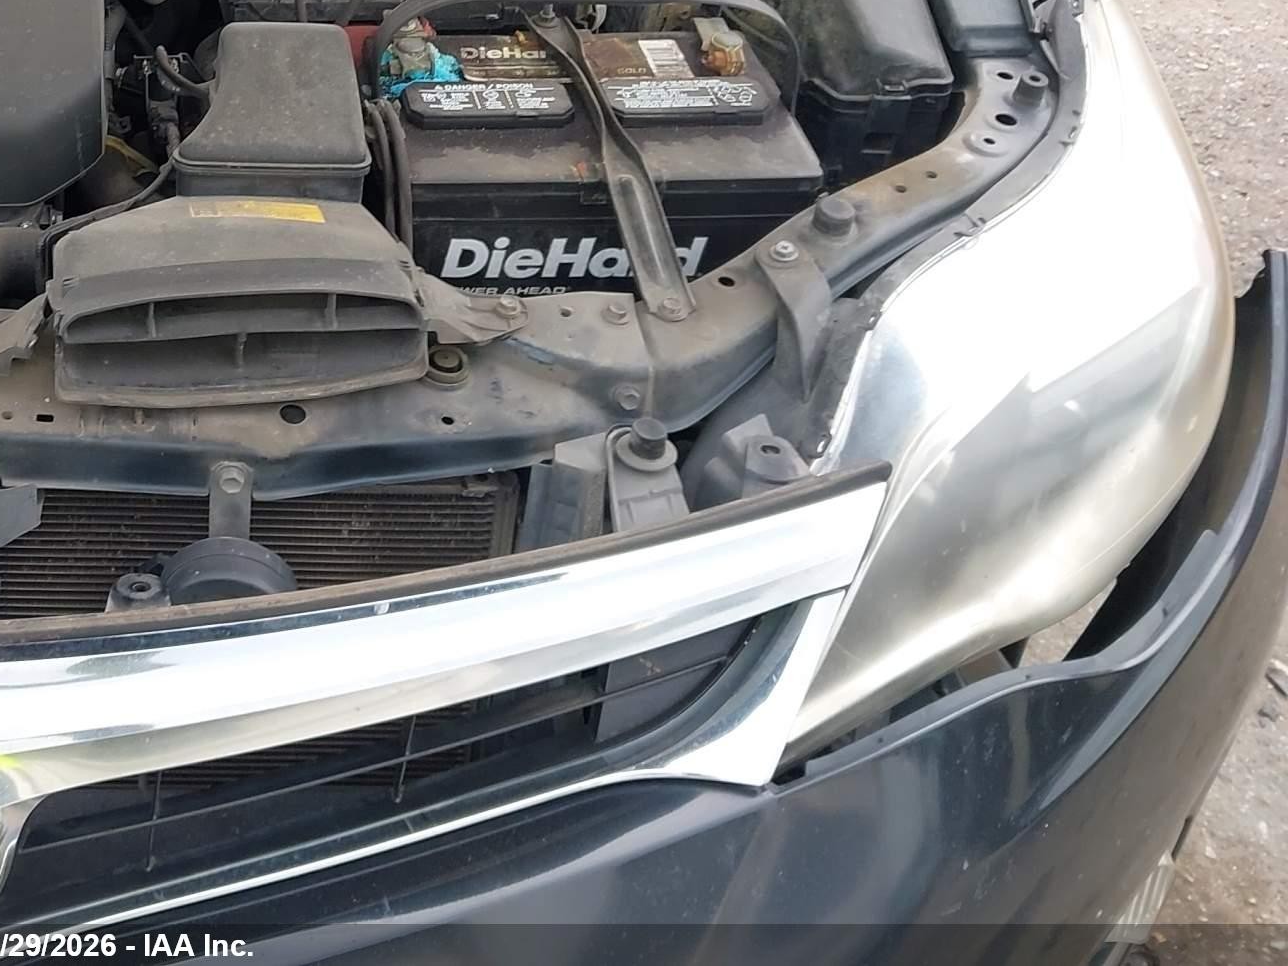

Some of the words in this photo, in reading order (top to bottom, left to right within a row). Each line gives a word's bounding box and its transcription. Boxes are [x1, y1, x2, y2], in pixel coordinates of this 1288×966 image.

[444, 83, 486, 91] DANGER
[496, 83, 534, 91] POISON
[440, 237, 709, 279] DieHad
[506, 286, 566, 295] AHEAD
